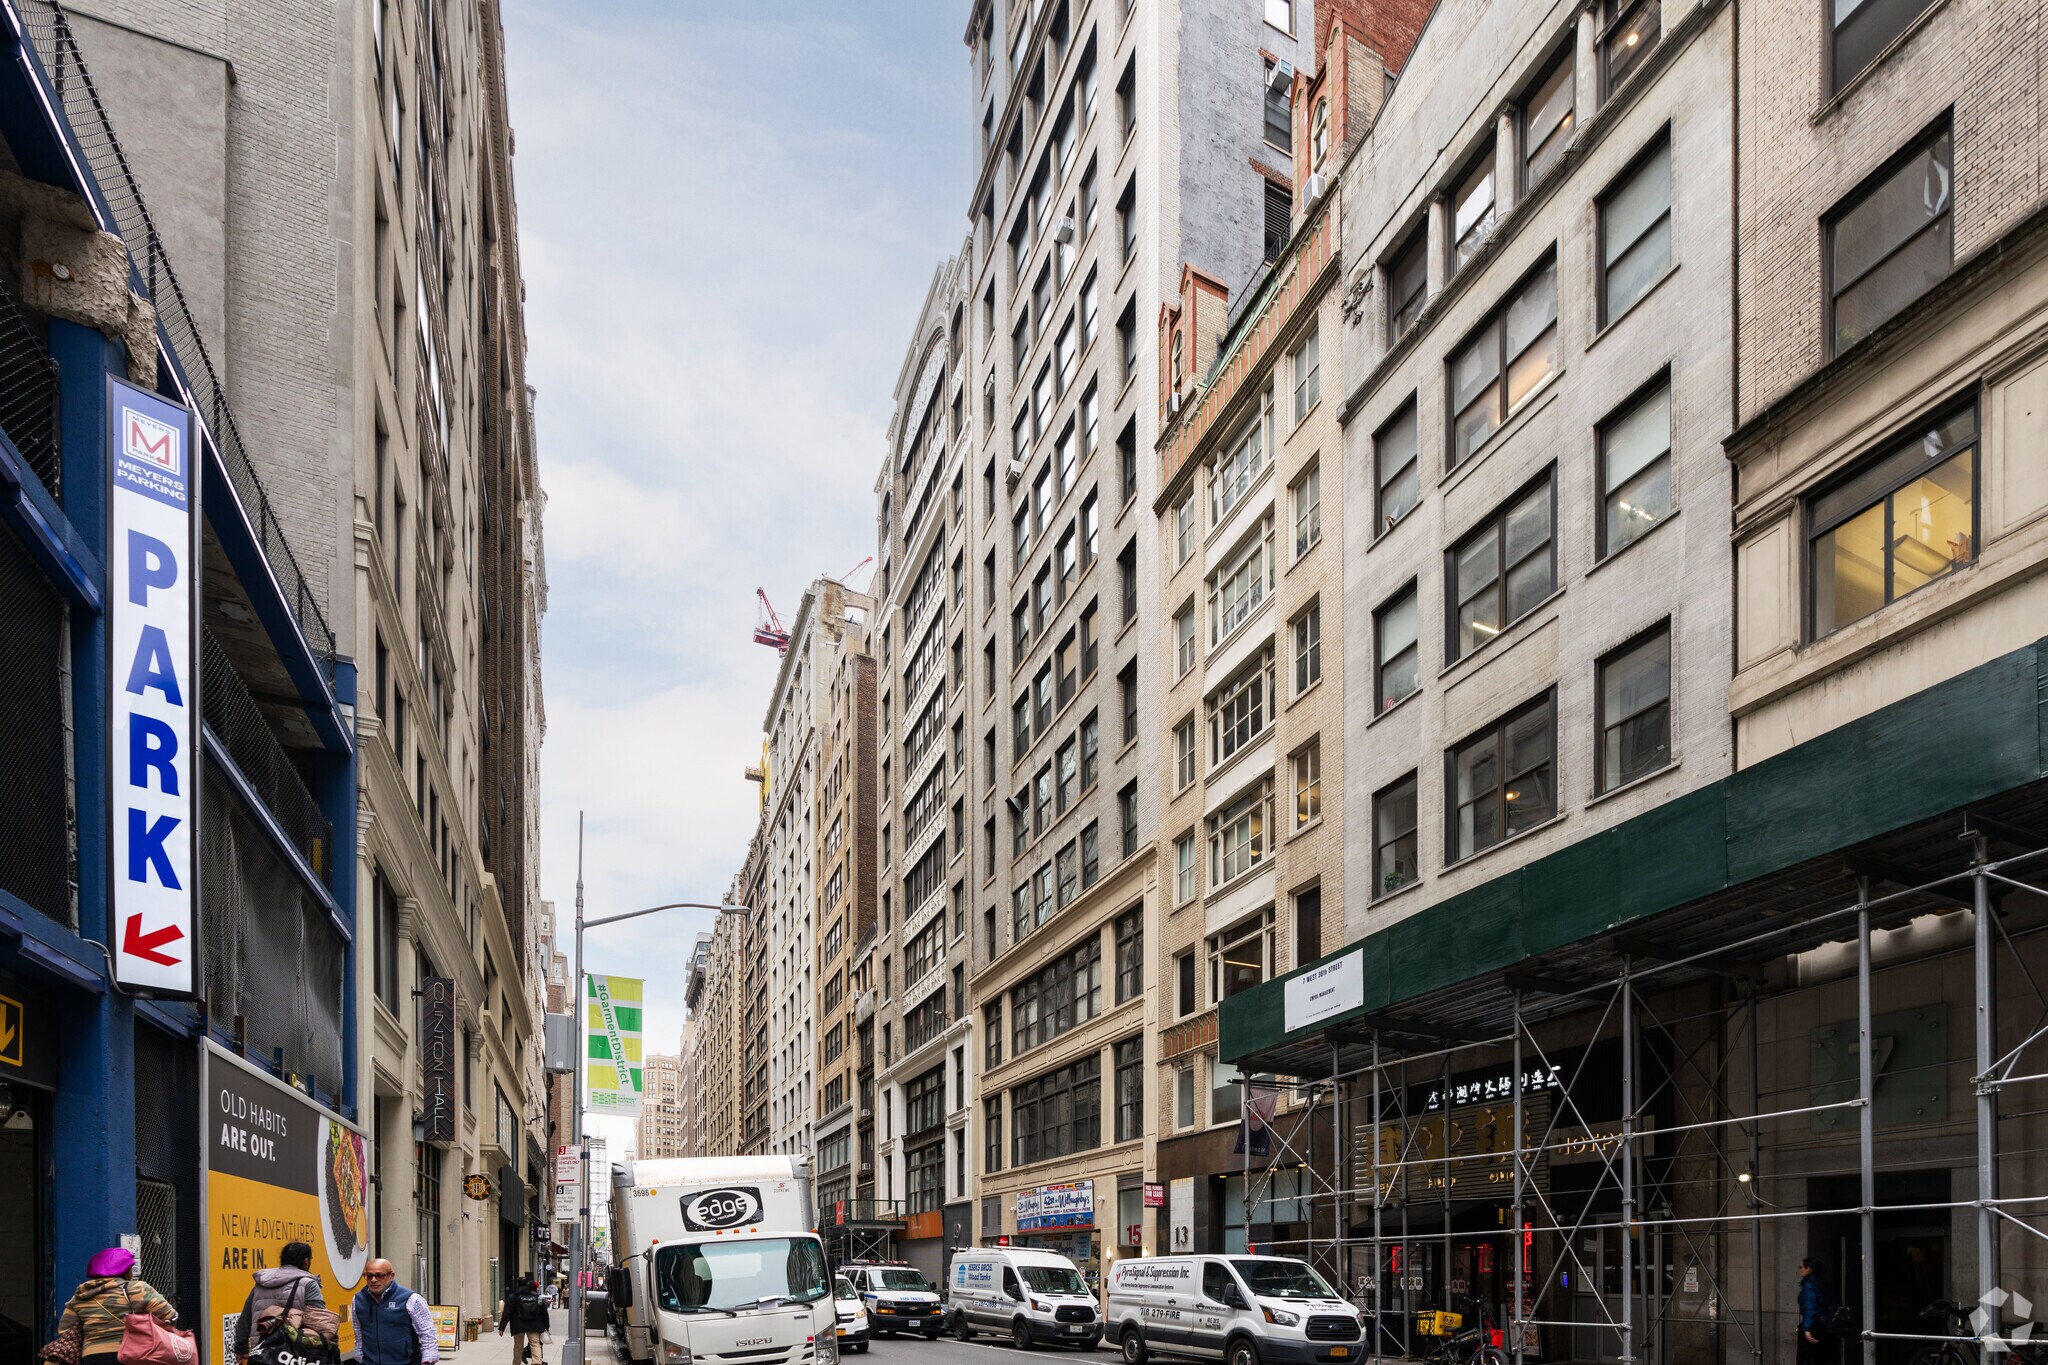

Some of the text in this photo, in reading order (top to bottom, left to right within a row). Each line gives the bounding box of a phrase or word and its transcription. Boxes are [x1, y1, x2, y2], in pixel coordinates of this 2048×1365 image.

[132, 416, 171, 435] MEYERS
[117, 468, 186, 501] PARKING
[118, 459, 184, 490] MEYERS
[125, 528, 184, 891] PARK
[1307, 973, 1317, 983] WEST
[1328, 961, 1343, 974] STREET
[597, 984, 629, 1084] #GarmentDistrict
[434, 982, 444, 1135] CLINTON HALL
[221, 1089, 287, 1137] OLD HABITS
[221, 1123, 276, 1162] ARE OUT.
[560, 1146, 565, 1154] 3
[698, 1198, 746, 1220] edge
[222, 1213, 315, 1243] NEW ADVENTURES
[1127, 1224, 1142, 1245] 15
[1175, 1226, 1188, 1244] 13
[222, 1247, 267, 1270] ARE IN.
[1121, 1266, 1145, 1280] PyroSignal
[1150, 1266, 1179, 1281] Suppression
[1180, 1266, 1190, 1278] Inc.
[1140, 1308, 1180, 1319] 718 279-FIRE
[735, 1337, 772, 1347] ISUZU
